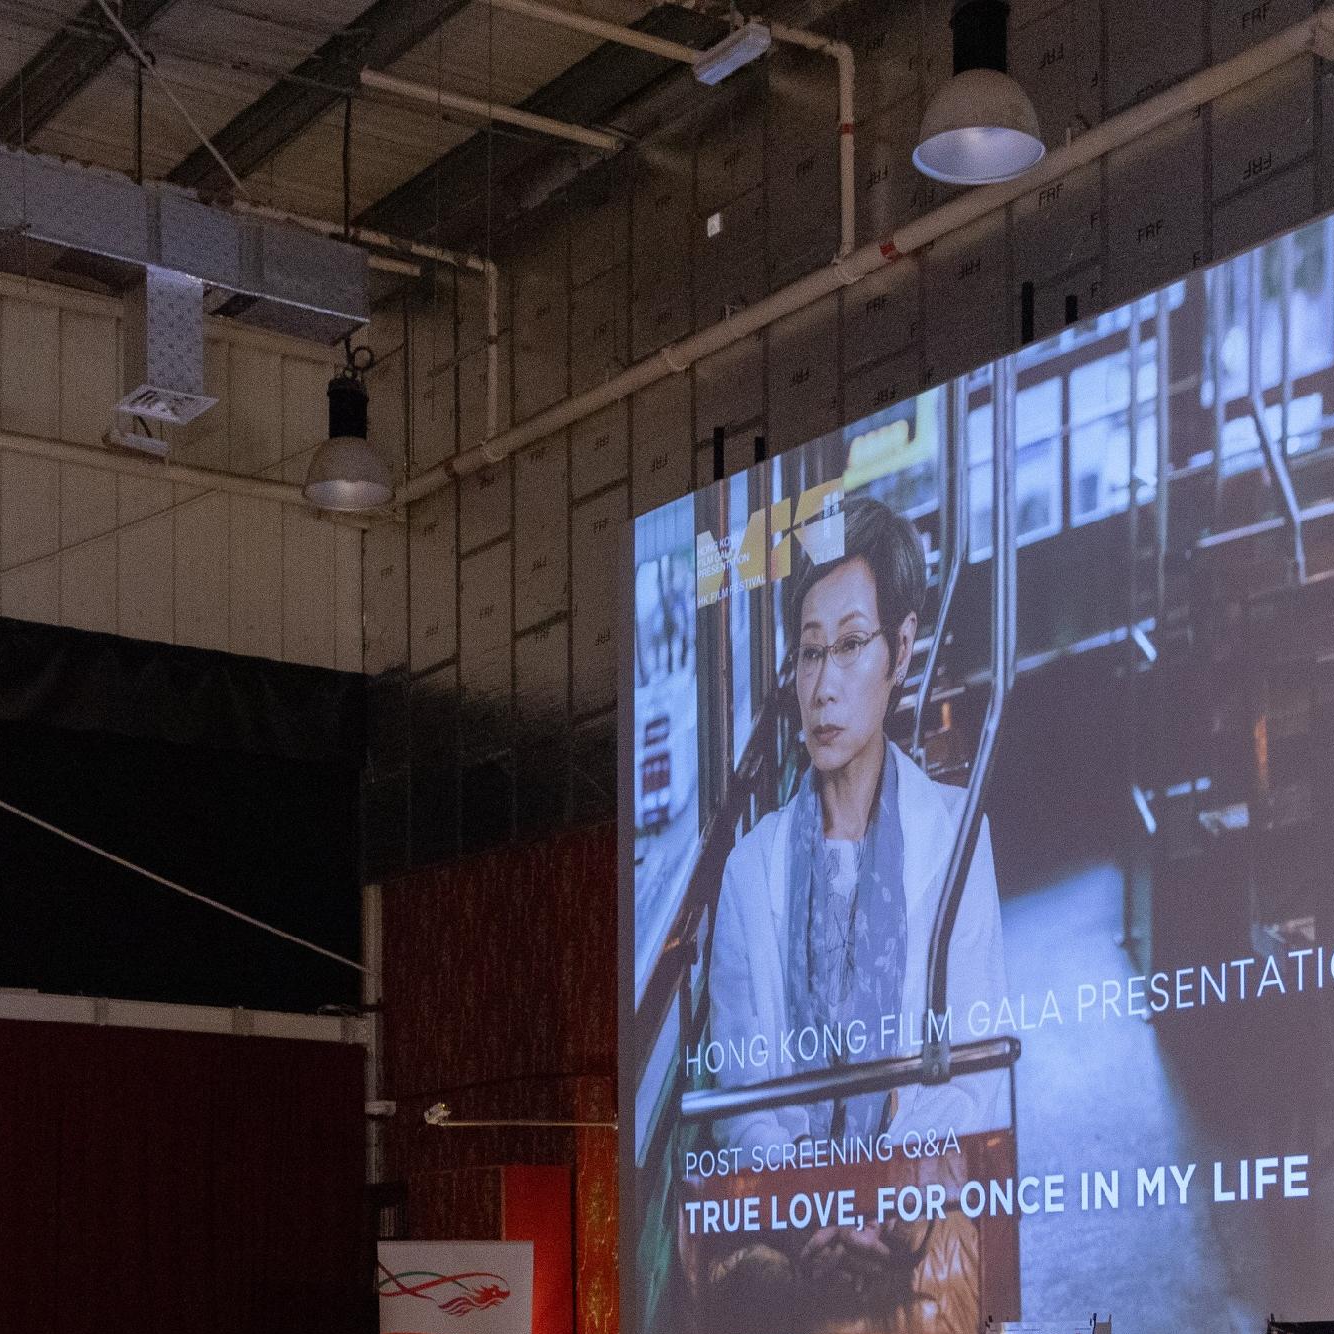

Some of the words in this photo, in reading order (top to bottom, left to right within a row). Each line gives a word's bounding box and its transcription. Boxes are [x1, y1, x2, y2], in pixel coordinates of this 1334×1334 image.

[1243, 153, 1272, 181] FRF
[685, 1034, 768, 1078] HONG
[780, 1022, 868, 1063] KONG
[880, 1010, 953, 1052] FILM
[967, 991, 1063, 1038] GALA
[686, 1145, 743, 1179] POST
[751, 1132, 894, 1174] SCREENING
[902, 1125, 962, 1162] Q&A
[685, 1198, 761, 1235] TRUE
[770, 1189, 866, 1233] LOVE,
[877, 1184, 948, 1227] FOR
[960, 1171, 1066, 1219] ONCE
[1079, 1168, 1121, 1212] IN
[1137, 1163, 1200, 1208] MY
[1213, 1155, 1310, 1204] LIFE
